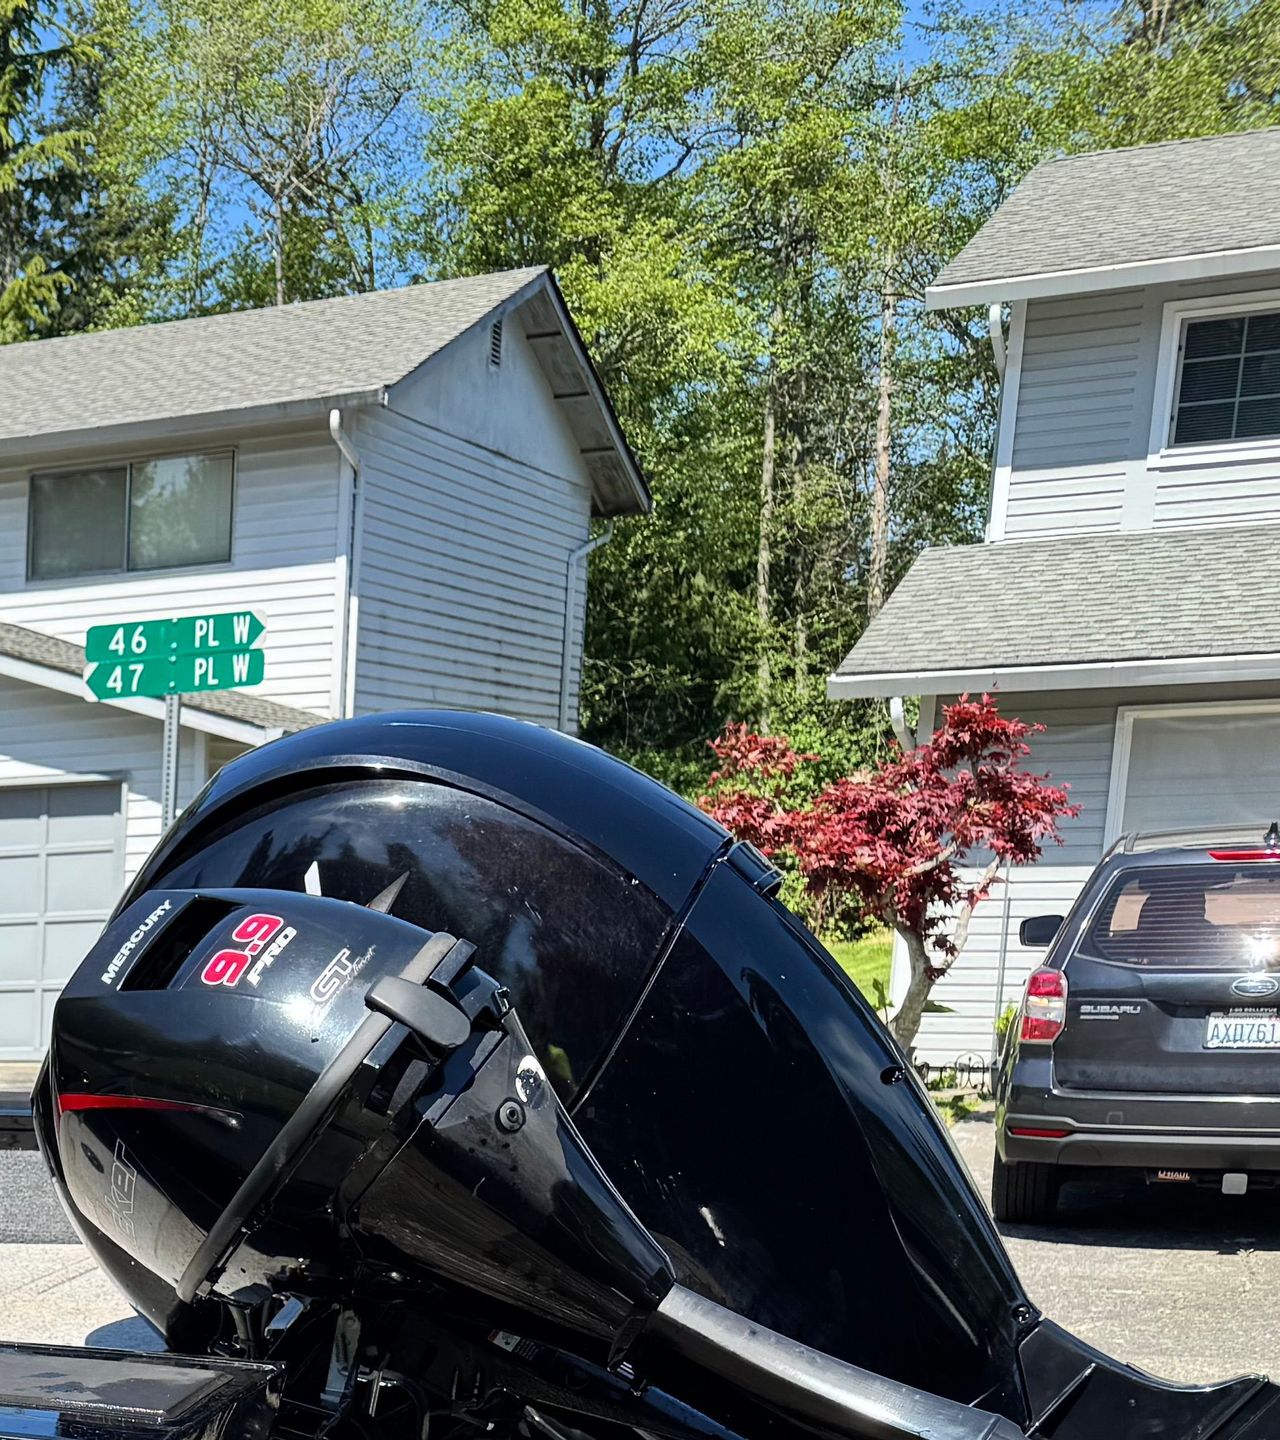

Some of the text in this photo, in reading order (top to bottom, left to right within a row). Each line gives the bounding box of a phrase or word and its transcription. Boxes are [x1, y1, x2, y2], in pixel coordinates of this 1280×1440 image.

[108, 614, 251, 656] 46 PL W
[105, 653, 250, 694] 47 PL W
[101, 899, 173, 985] MERCURY
[200, 913, 285, 987] 9.9
[247, 926, 298, 988] PRO
[1080, 1005, 1141, 1014] SUBARU
[1211, 1023, 1277, 1043] AXD761
